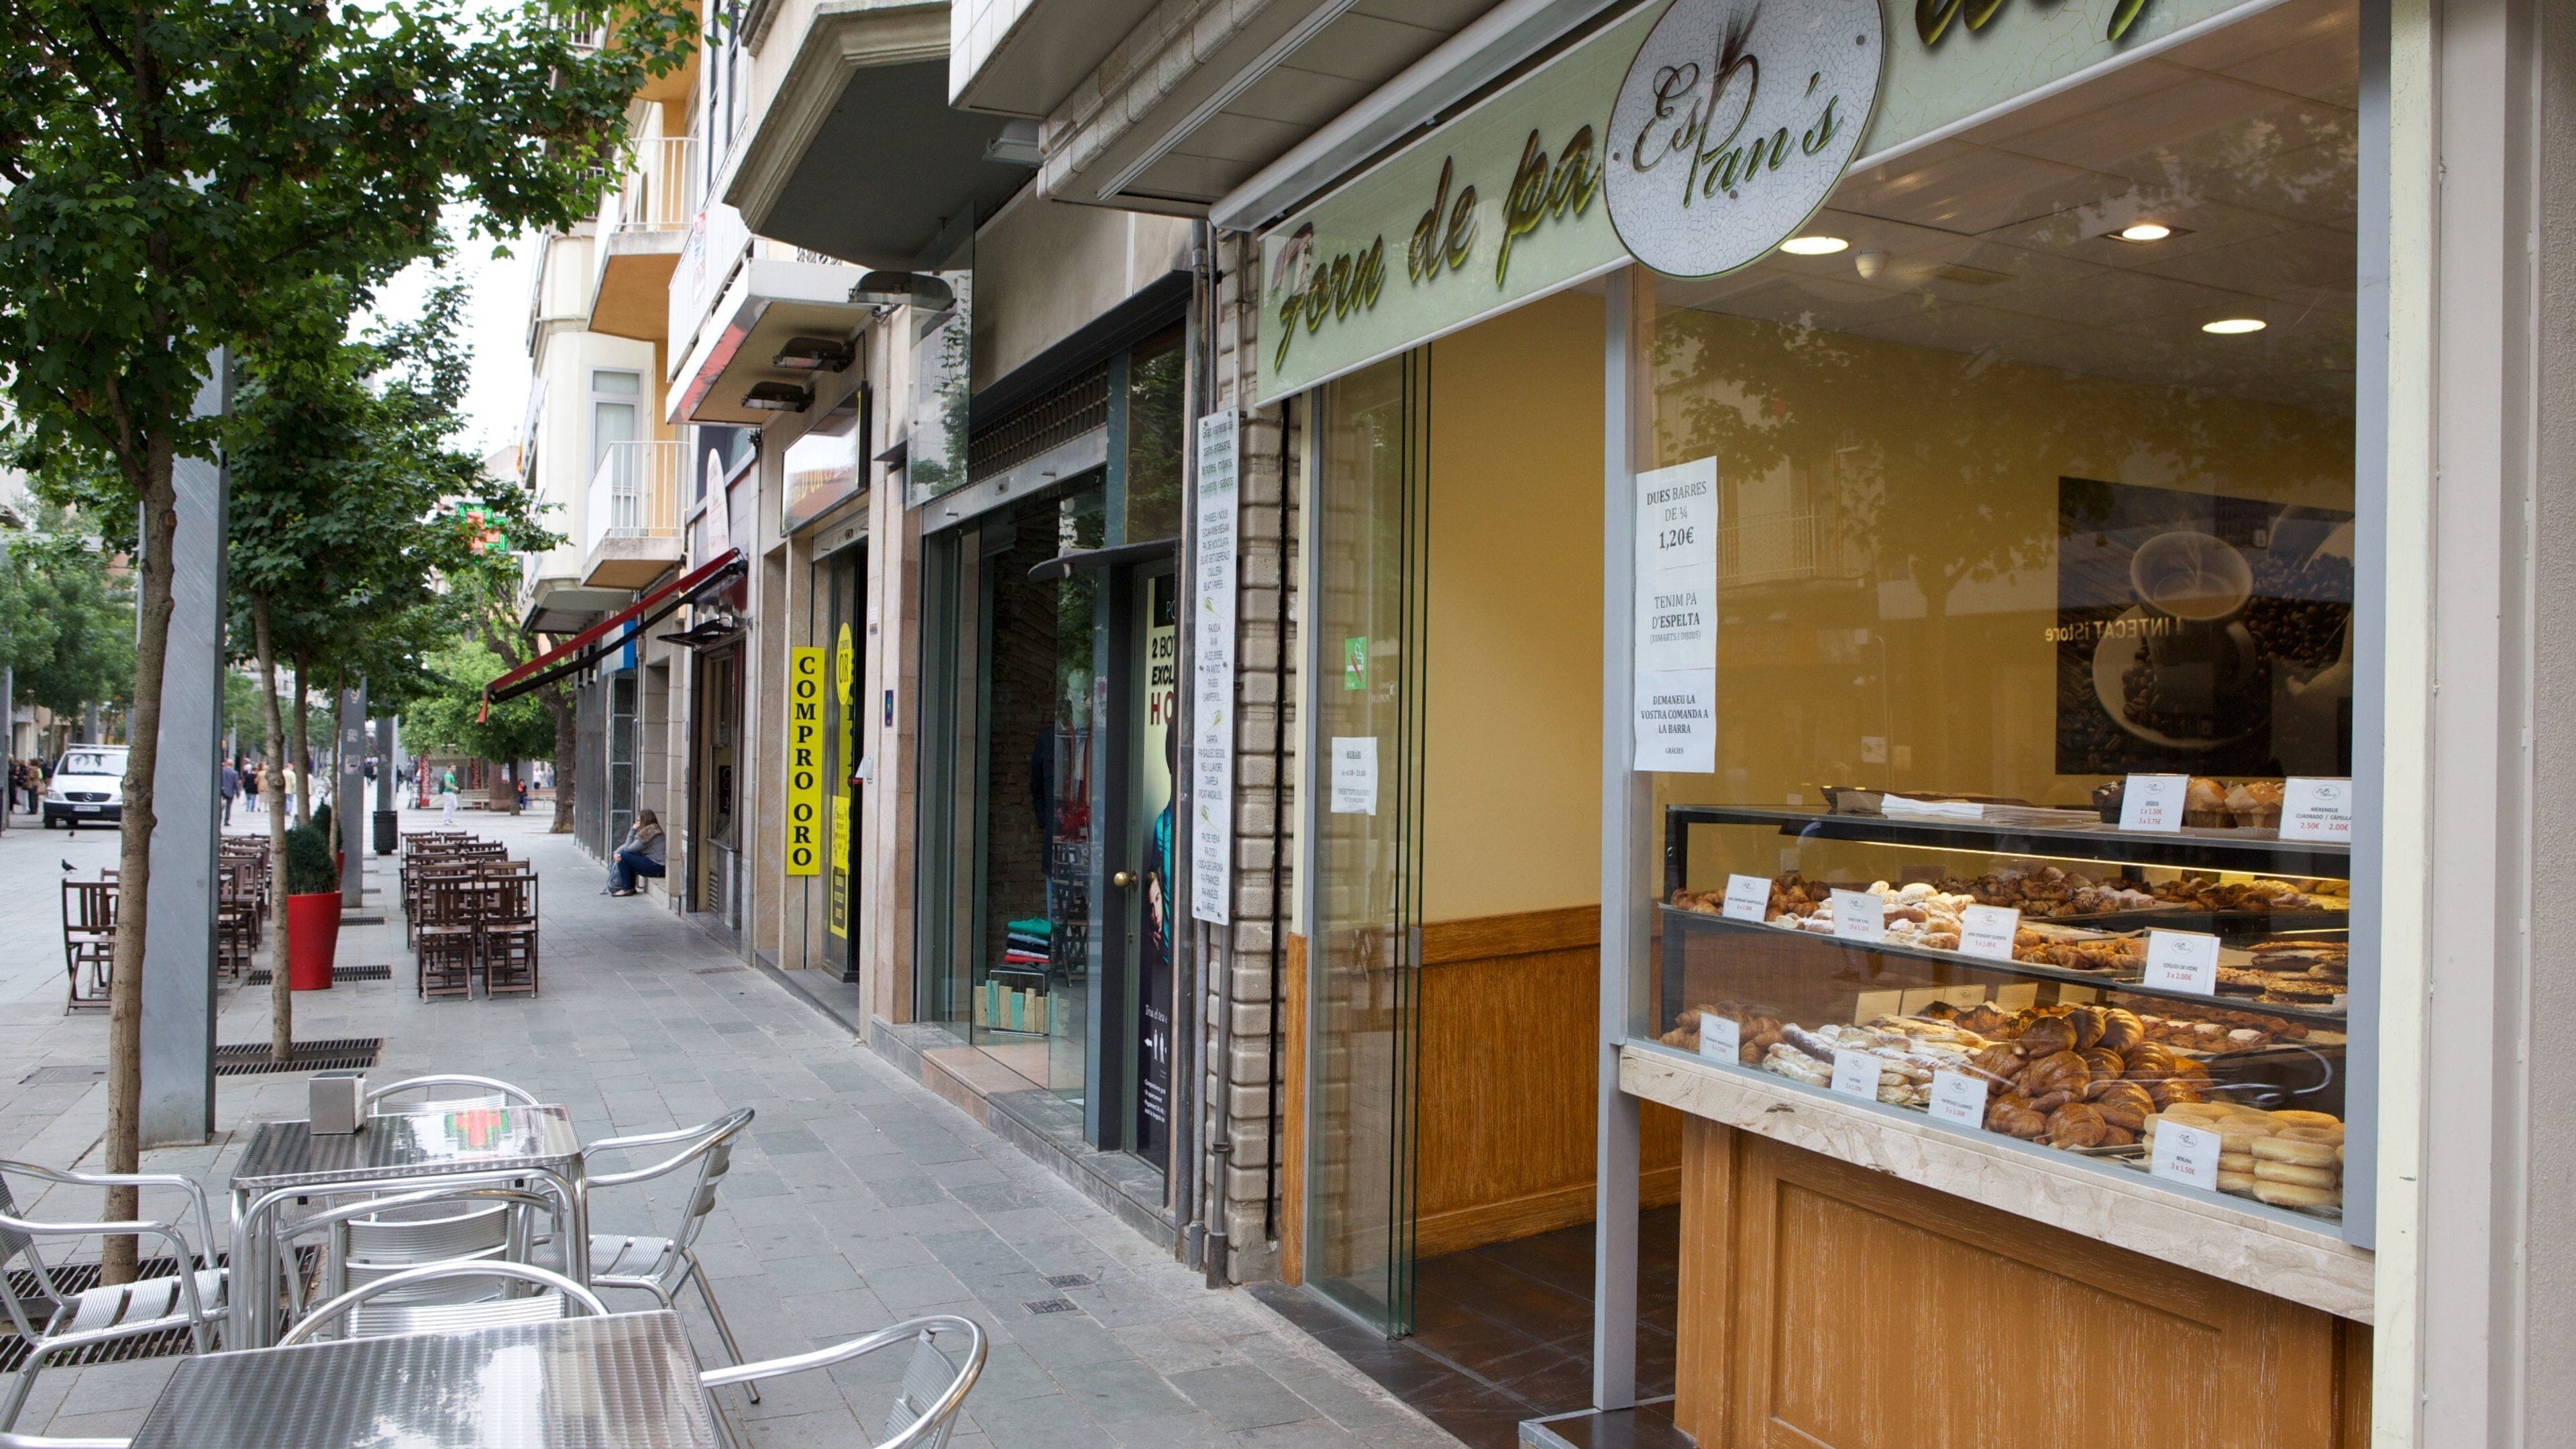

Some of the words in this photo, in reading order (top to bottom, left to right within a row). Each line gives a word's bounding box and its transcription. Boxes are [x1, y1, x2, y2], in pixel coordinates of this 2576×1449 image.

[1683, 54, 1844, 209] Pan's
[1271, 221, 1386, 372] Forn
[1407, 155, 1477, 283] de
[1495, 123, 1602, 286] pa
[1647, 489, 1670, 506] DUES
[1672, 481, 1707, 500] BARRES
[1665, 508, 1677, 522] DE
[1659, 526, 1694, 551] 1,20€
[1654, 594, 1683, 609] TENIM
[1686, 592, 1697, 606] PA
[1652, 612, 1701, 629] D'ESPELTA
[1152, 637, 1158, 658] 2
[1160, 635, 1175, 657] BO
[839, 653, 849, 684] OR
[1653, 695, 1685, 705] DEMANEU
[1686, 694, 1696, 704] LA
[1641, 710, 1667, 719] VOSTRA
[1668, 709, 1703, 719] COMANDA
[1703, 709, 1709, 718] A
[794, 656, 816, 790] COMPRO
[1658, 724, 1667, 734] LA
[1668, 724, 1691, 734] BARRA
[792, 803, 813, 866] ORO
[2329, 823, 2349, 831] 2.00€
[1154, 1008, 1158, 1019] el
[2180, 1166, 2196, 1175] 1.50€
